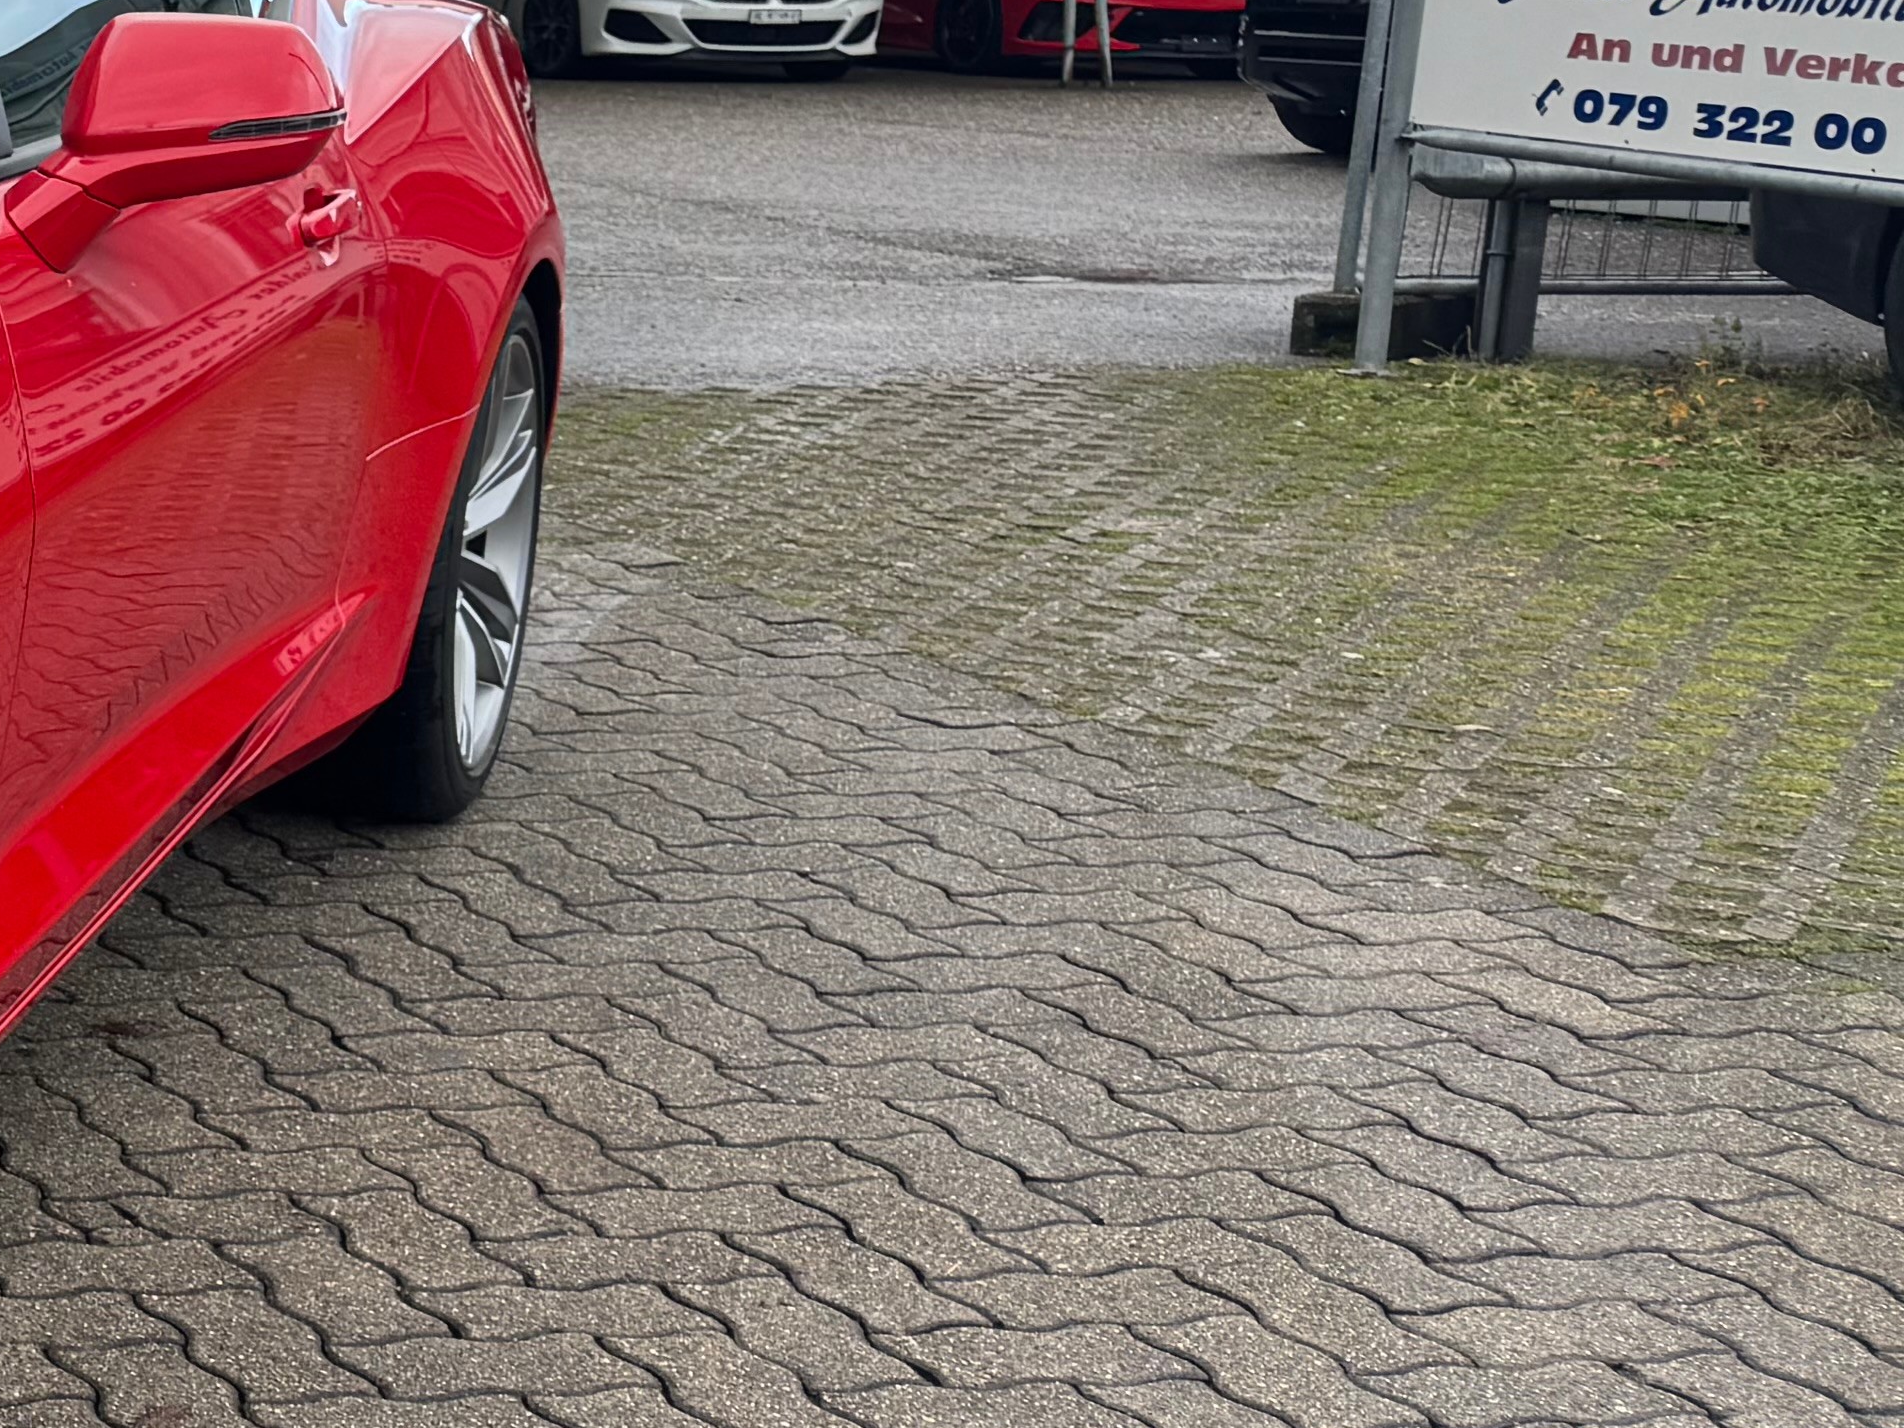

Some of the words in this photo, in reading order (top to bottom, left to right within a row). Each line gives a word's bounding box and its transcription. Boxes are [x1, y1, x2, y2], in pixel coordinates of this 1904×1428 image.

[1566, 31, 1632, 64] An
[1650, 42, 1746, 74] und
[1572, 88, 1669, 132] 079
[1692, 102, 1796, 147] 322
[1813, 112, 1888, 155] 00
